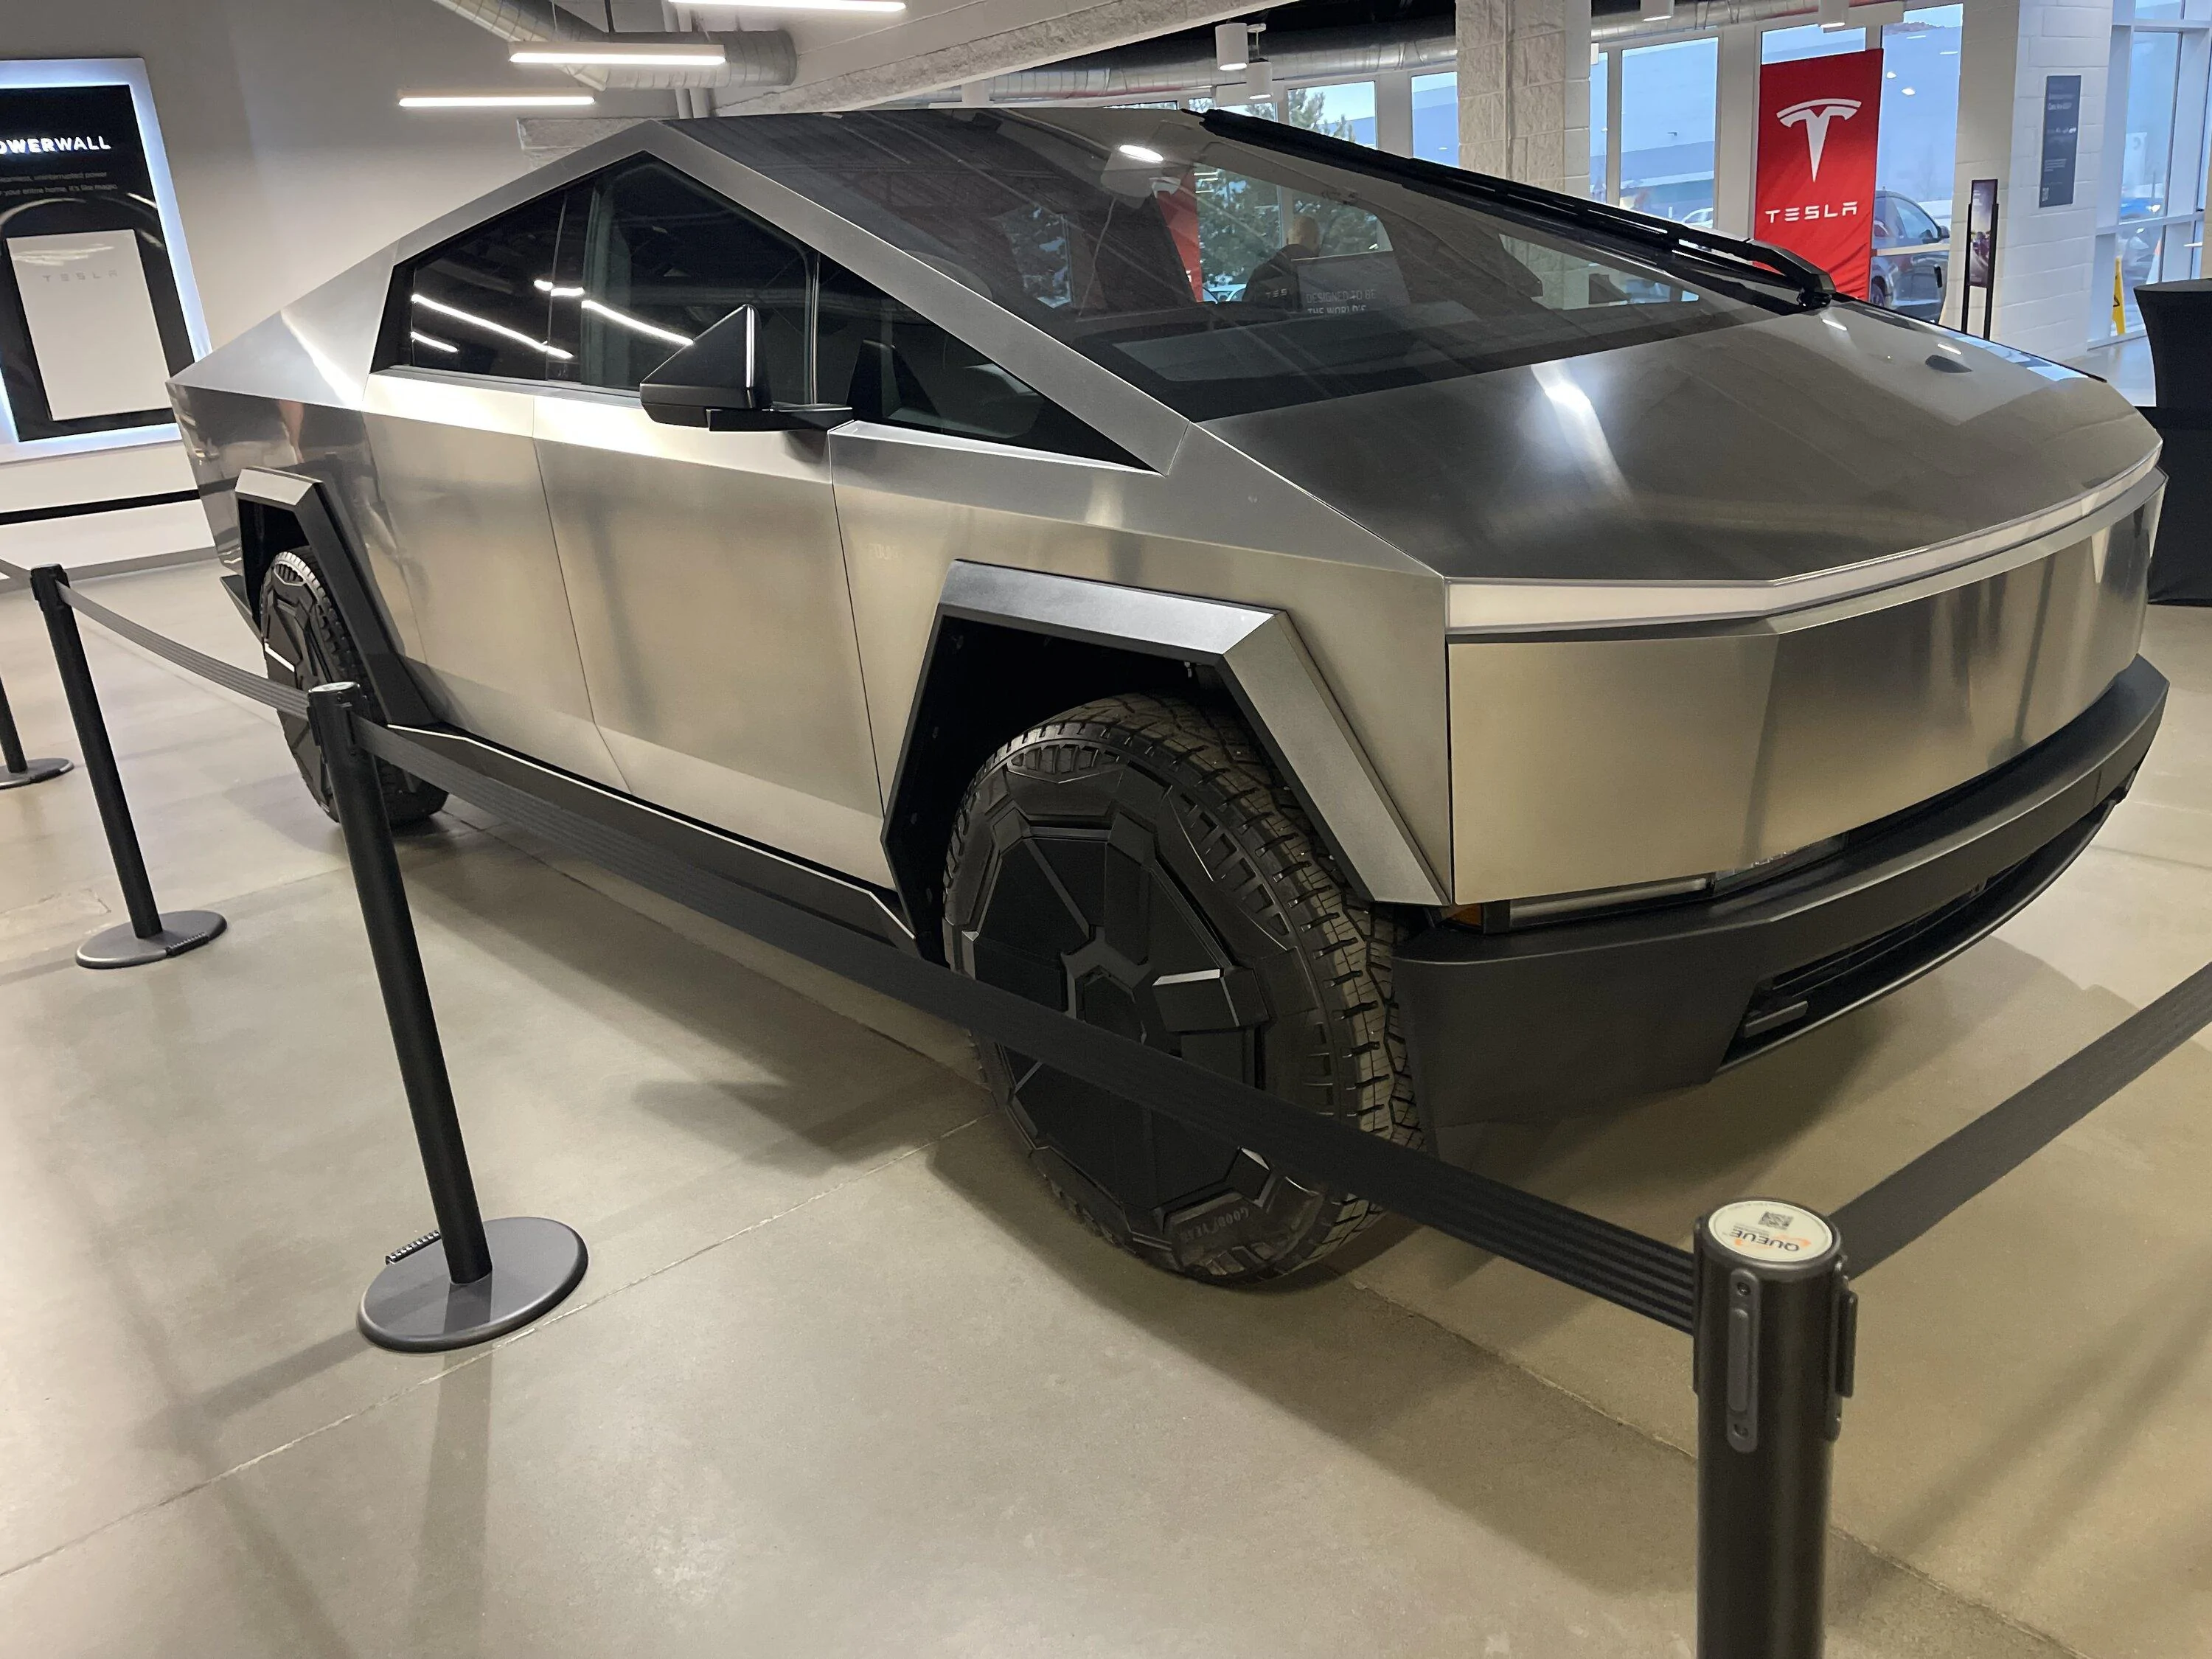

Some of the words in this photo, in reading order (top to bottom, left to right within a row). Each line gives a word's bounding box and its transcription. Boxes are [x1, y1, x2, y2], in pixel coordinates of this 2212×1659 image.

[1764, 201, 1858, 223] TESLA
[42, 270, 118, 282] TESLA
[1306, 291, 1350, 304] DESIGNED
[1364, 289, 1377, 299] BE
[1730, 1228, 1800, 1252] QUEUE
